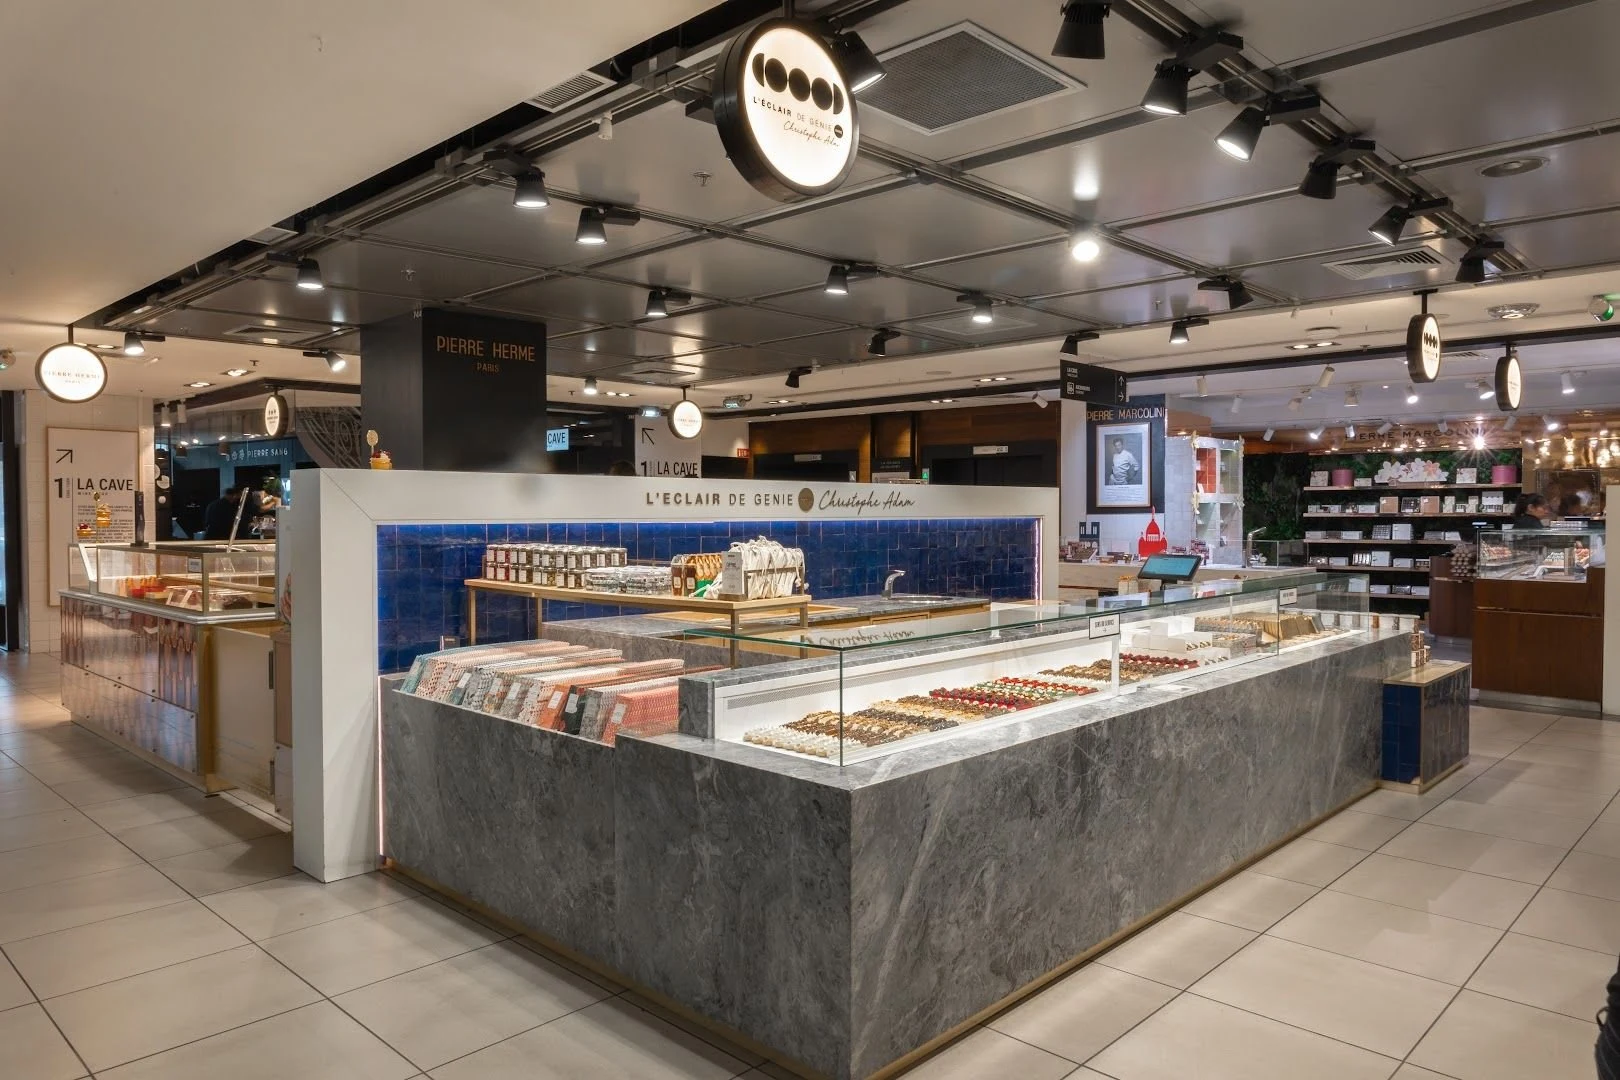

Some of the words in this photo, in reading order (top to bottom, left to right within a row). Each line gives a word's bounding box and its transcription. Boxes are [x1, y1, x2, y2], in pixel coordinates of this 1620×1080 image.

[796, 112, 806, 122] DE
[436, 335, 484, 357] PIERRE
[492, 341, 536, 362] HERME
[476, 362, 500, 373] PARIS
[1086, 410, 1114, 422] PIERRE
[1118, 406, 1166, 420] MARCOLINI
[548, 432, 566, 444] CAVE
[248, 448, 269, 458] PIERRE
[271, 448, 288, 456] SANG
[657, 460, 670, 475] LA
[673, 462, 698, 477] CAVE
[54, 478, 63, 498] 1
[77, 478, 94, 490] LA
[99, 478, 133, 490] CAVE
[646, 492, 722, 505] L'ECLAIR
[729, 493, 746, 506] DE
[754, 493, 794, 506] GENIE
[818, 490, 881, 515] Christophe
[882, 490, 916, 511] Adam
